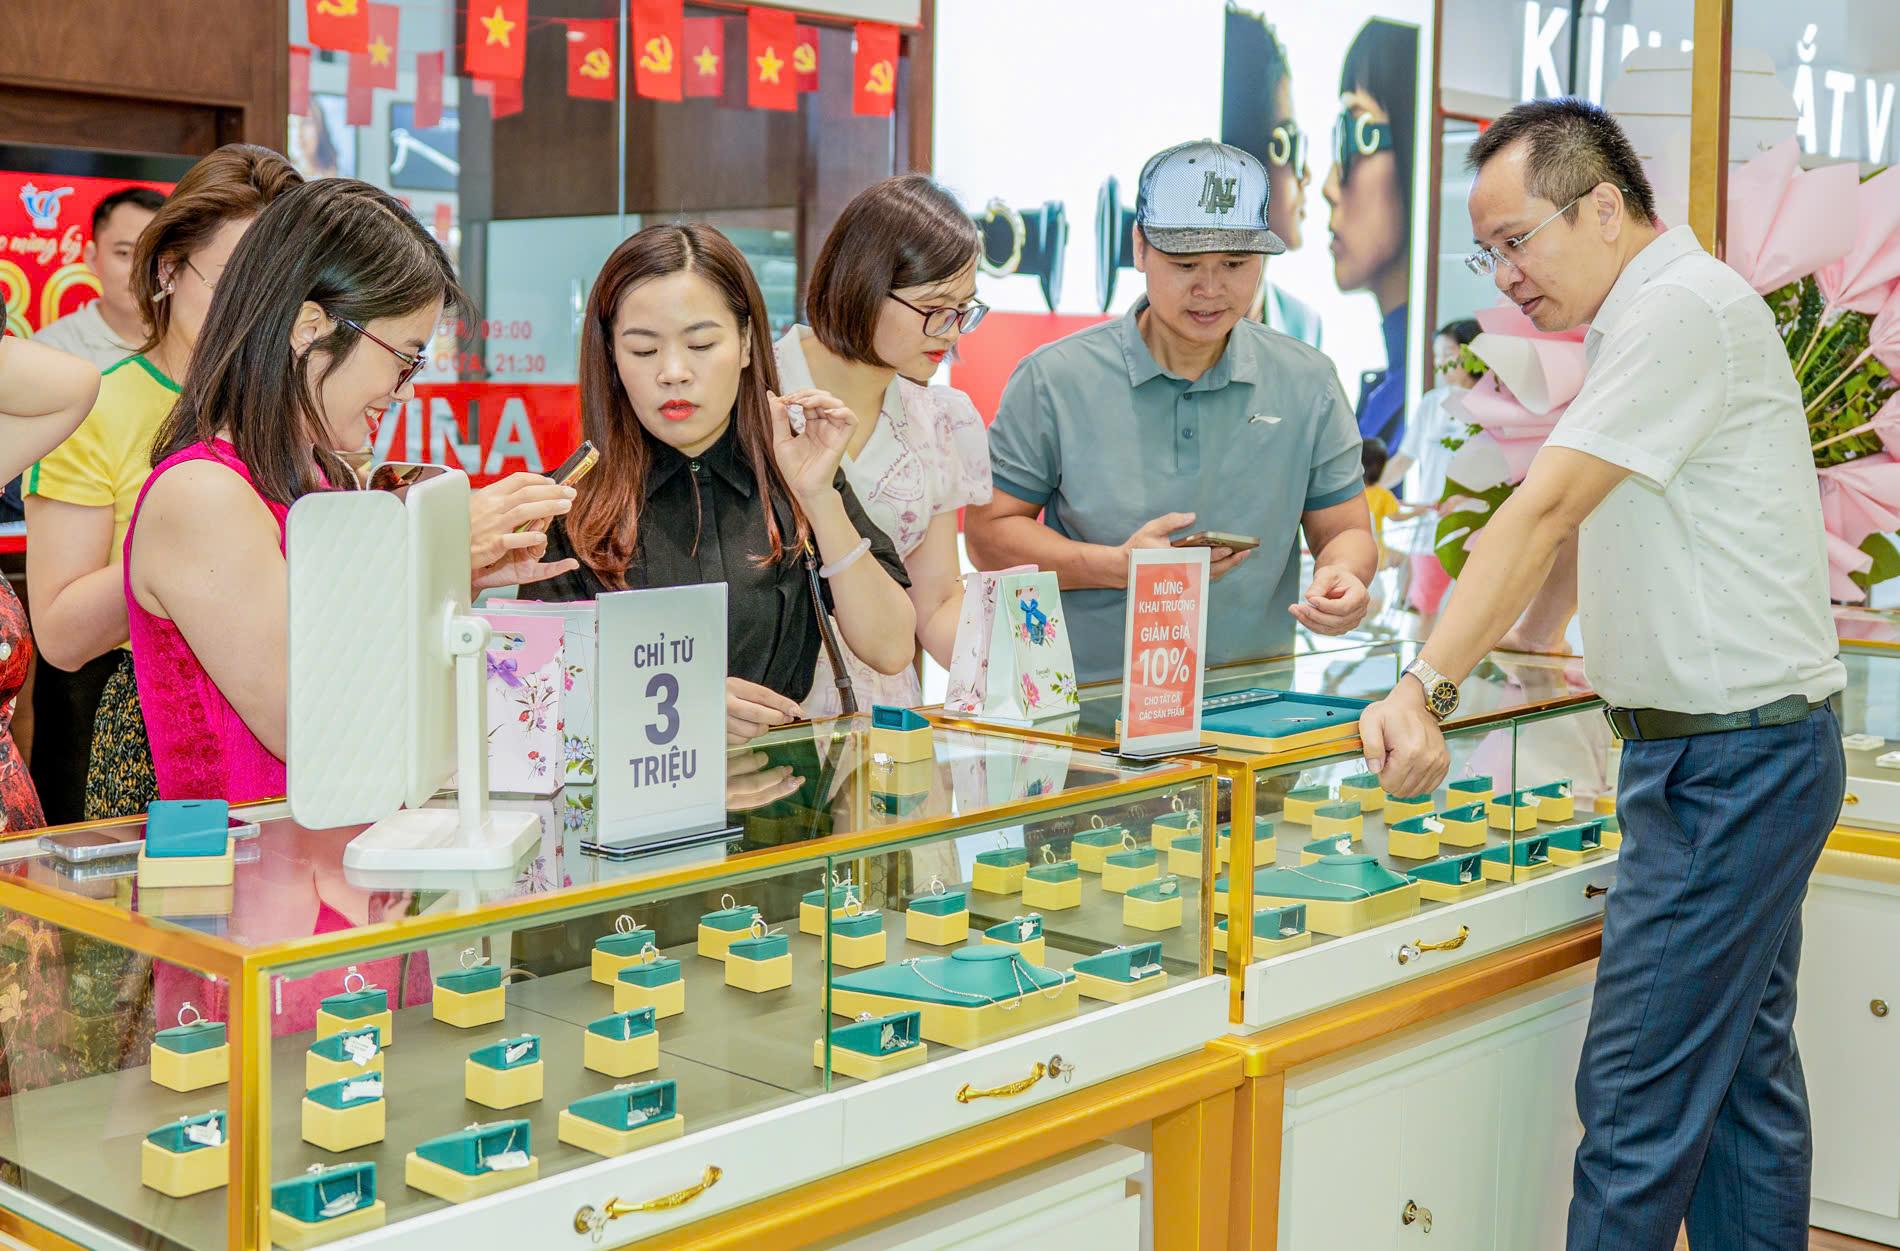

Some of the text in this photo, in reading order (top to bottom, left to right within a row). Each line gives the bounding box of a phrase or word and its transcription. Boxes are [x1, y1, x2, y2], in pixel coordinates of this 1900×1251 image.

[495, 353, 546, 372] 21:30
[1153, 579, 1184, 596] MỪNG
[1138, 600, 1160, 614] KHAI
[634, 632, 695, 668] CHỈ TỪ
[1139, 646, 1190, 687] 10%
[644, 673, 680, 745] 3
[1144, 695, 1159, 706] CHO
[1139, 708, 1153, 721] CÁC
[629, 745, 697, 789] TRIỆU
